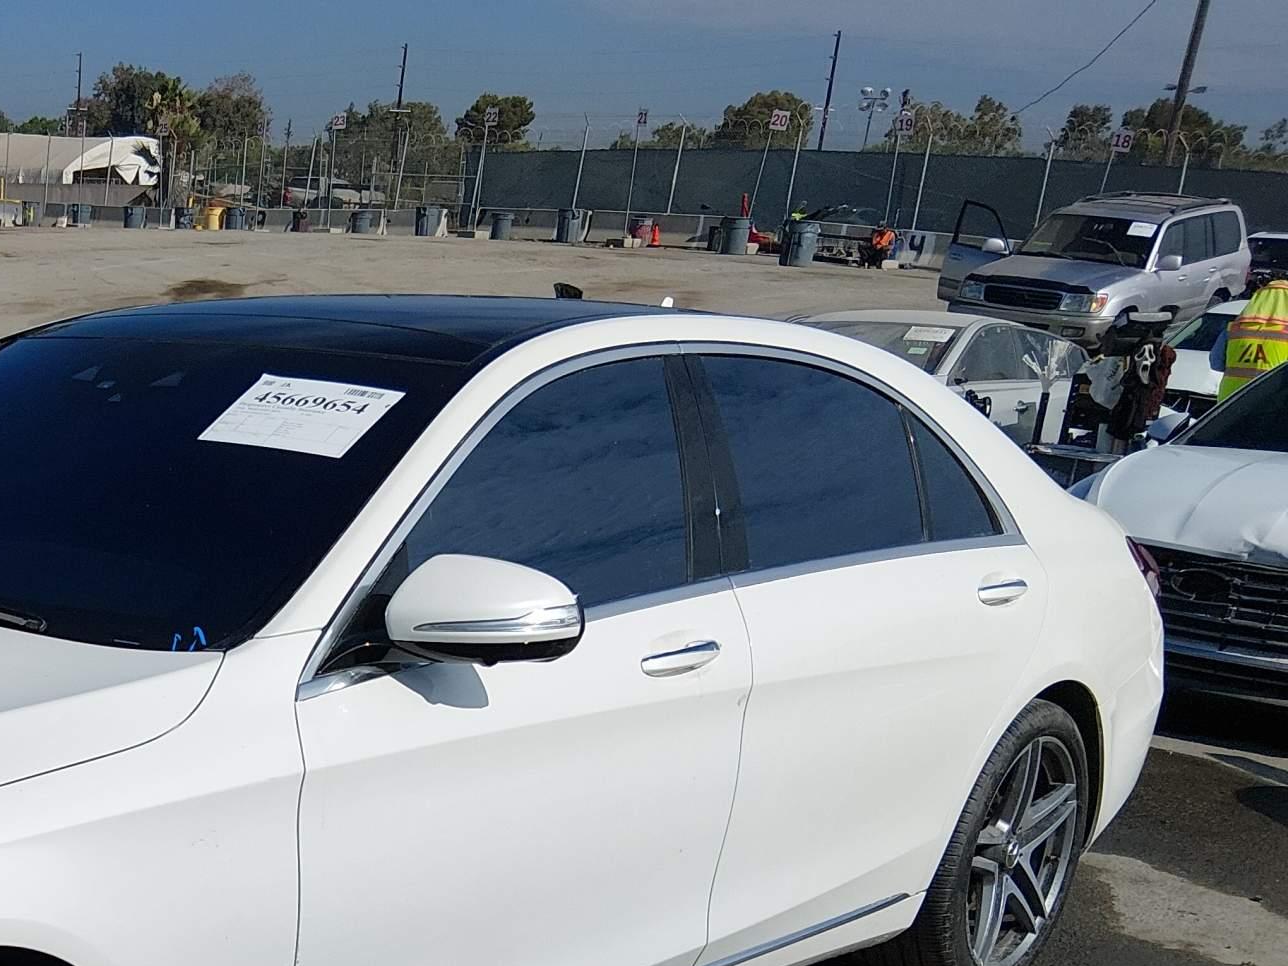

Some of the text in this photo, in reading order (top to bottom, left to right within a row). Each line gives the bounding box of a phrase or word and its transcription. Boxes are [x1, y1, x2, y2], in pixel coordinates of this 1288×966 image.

[334, 115, 346, 126] 23
[485, 111, 498, 123] 22
[637, 111, 648, 124] 21
[771, 113, 788, 127] 20
[898, 118, 913, 131] 19
[1112, 134, 1132, 148] 18
[909, 234, 926, 262] 4
[253, 391, 371, 415] 45669654
